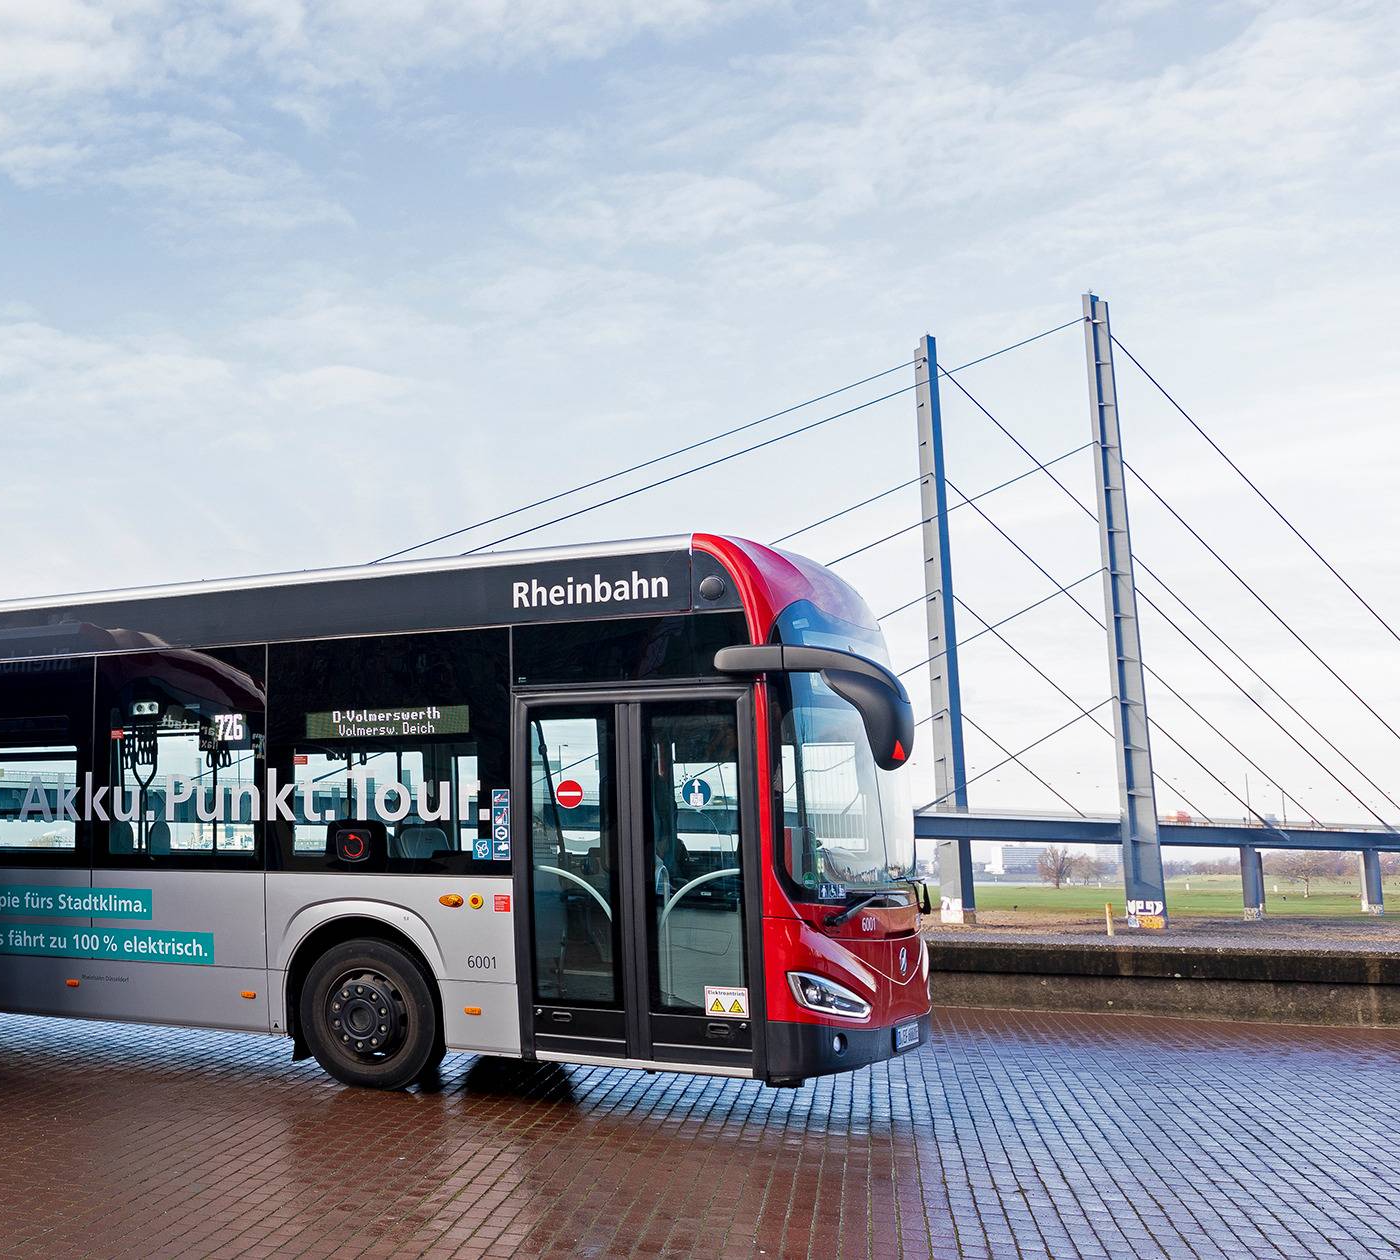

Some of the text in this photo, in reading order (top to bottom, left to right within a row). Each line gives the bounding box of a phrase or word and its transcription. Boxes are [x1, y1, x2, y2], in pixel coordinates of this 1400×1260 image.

[513, 571, 669, 608] Rheinbahn
[332, 706, 441, 723] D-Volmerswerth
[214, 714, 243, 741] 726
[338, 723, 435, 737] Volmersw. Deich
[24, 892, 53, 909] fürs
[58, 893, 147, 913] Stadtklima.
[8, 930, 45, 948] fährt
[49, 936, 67, 949] zu
[72, 933, 99, 951] 100
[103, 935, 118, 952] %
[123, 935, 208, 957] elektrisch.
[467, 955, 497, 969] 6001
